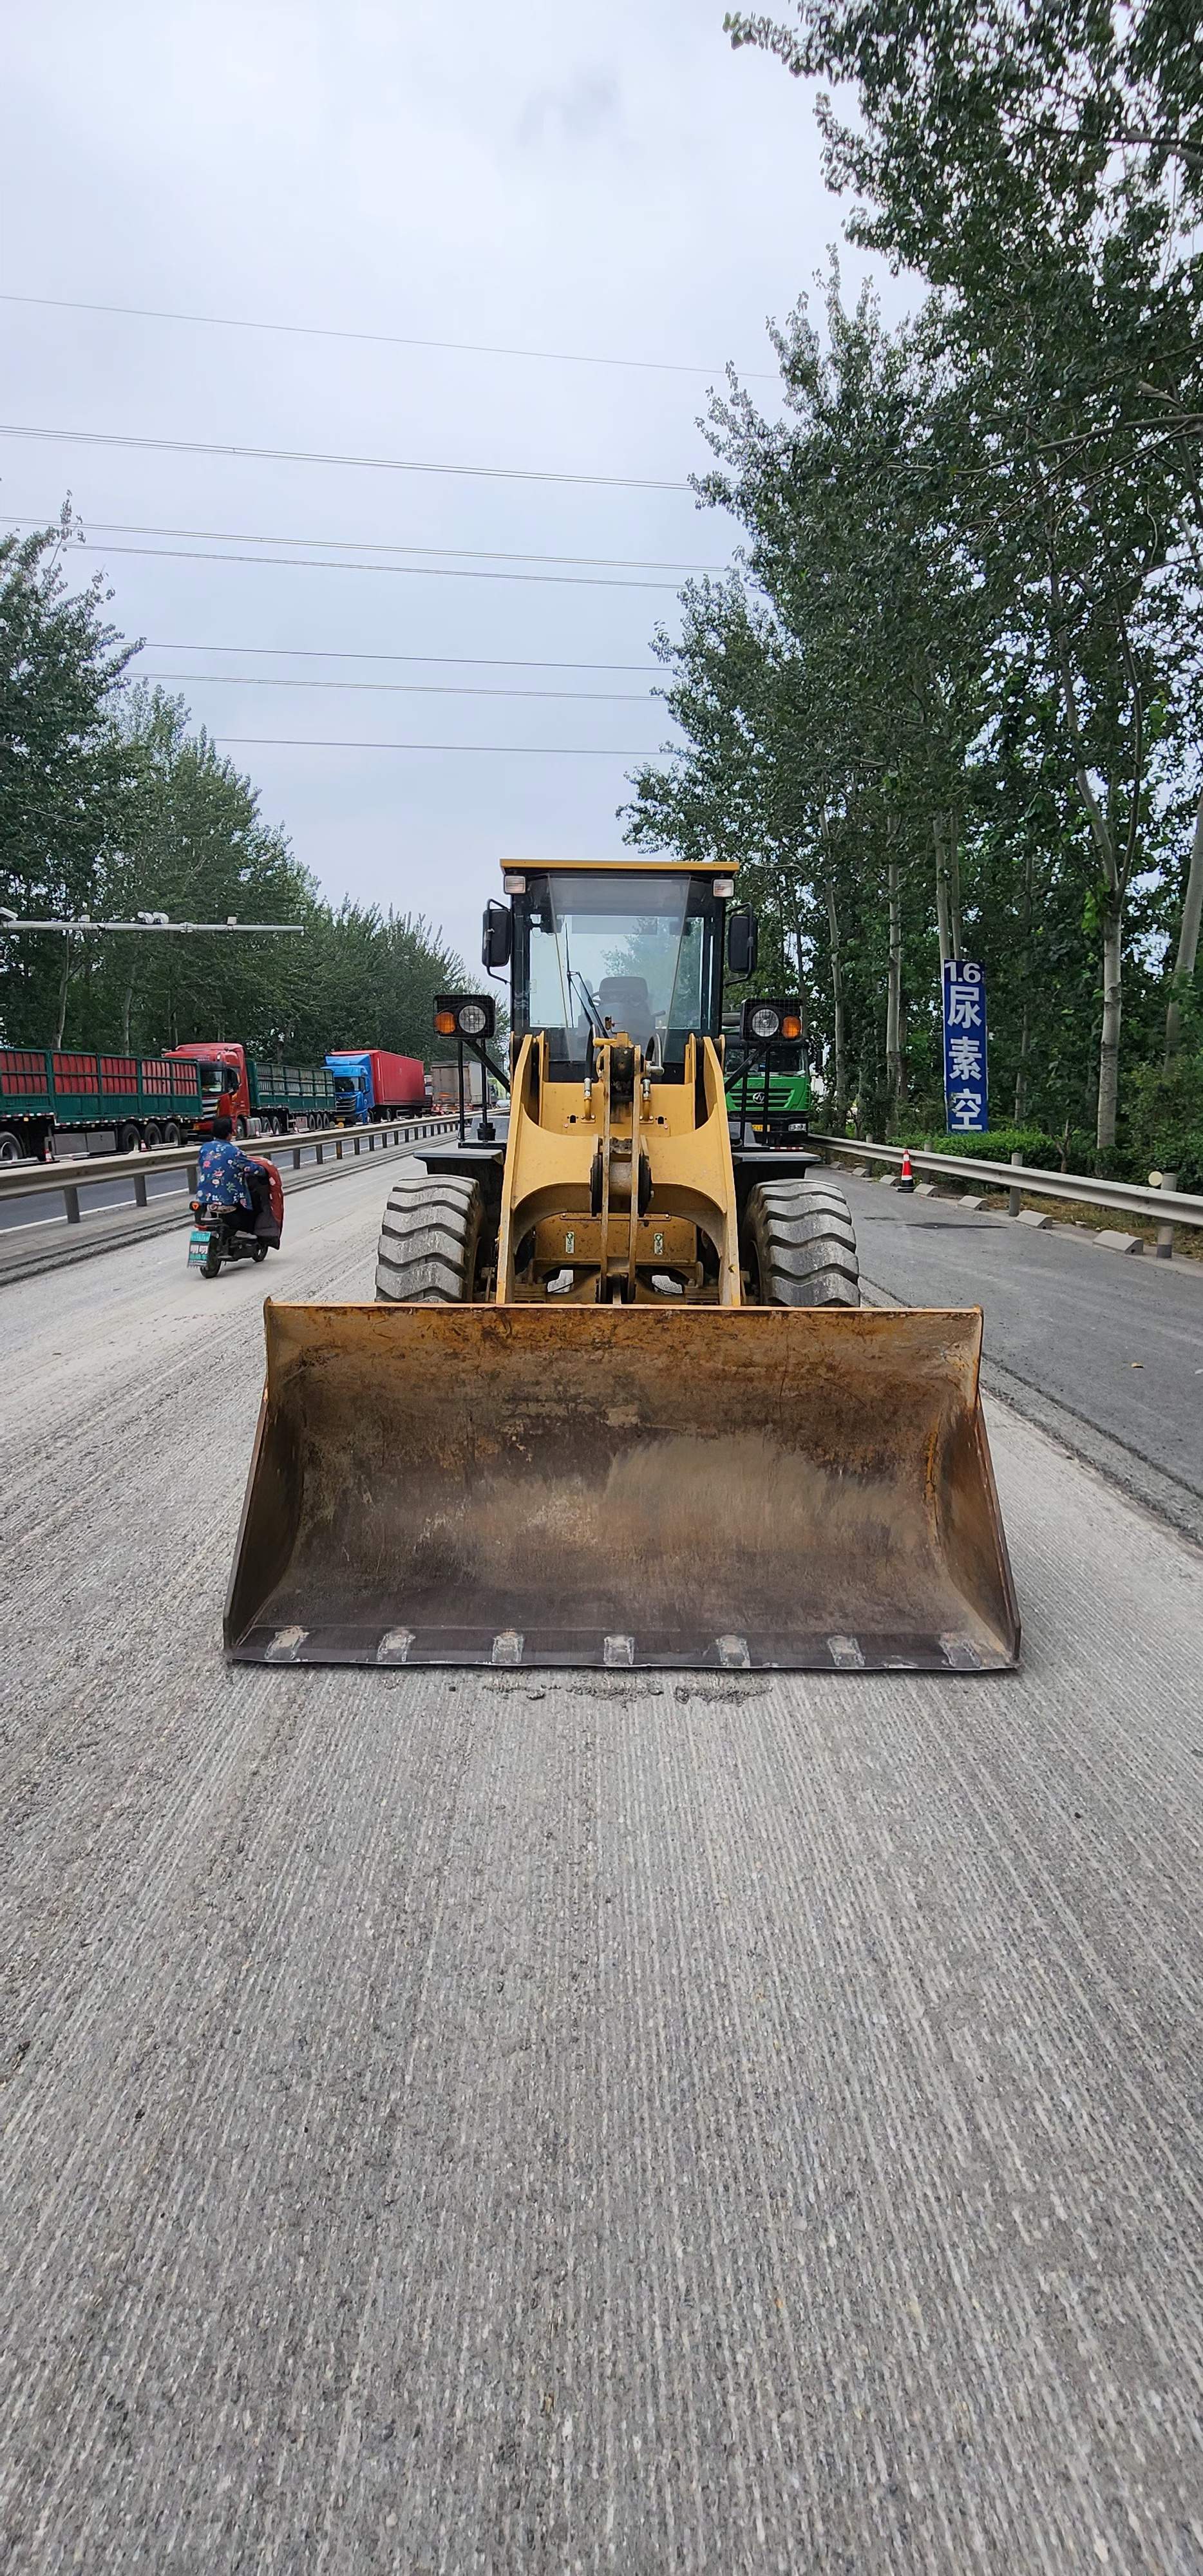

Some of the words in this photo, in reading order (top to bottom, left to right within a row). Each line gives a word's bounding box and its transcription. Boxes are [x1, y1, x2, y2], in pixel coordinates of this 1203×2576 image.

[945, 961, 981, 983] 1.6
[947, 985, 982, 1130] 尿素空
